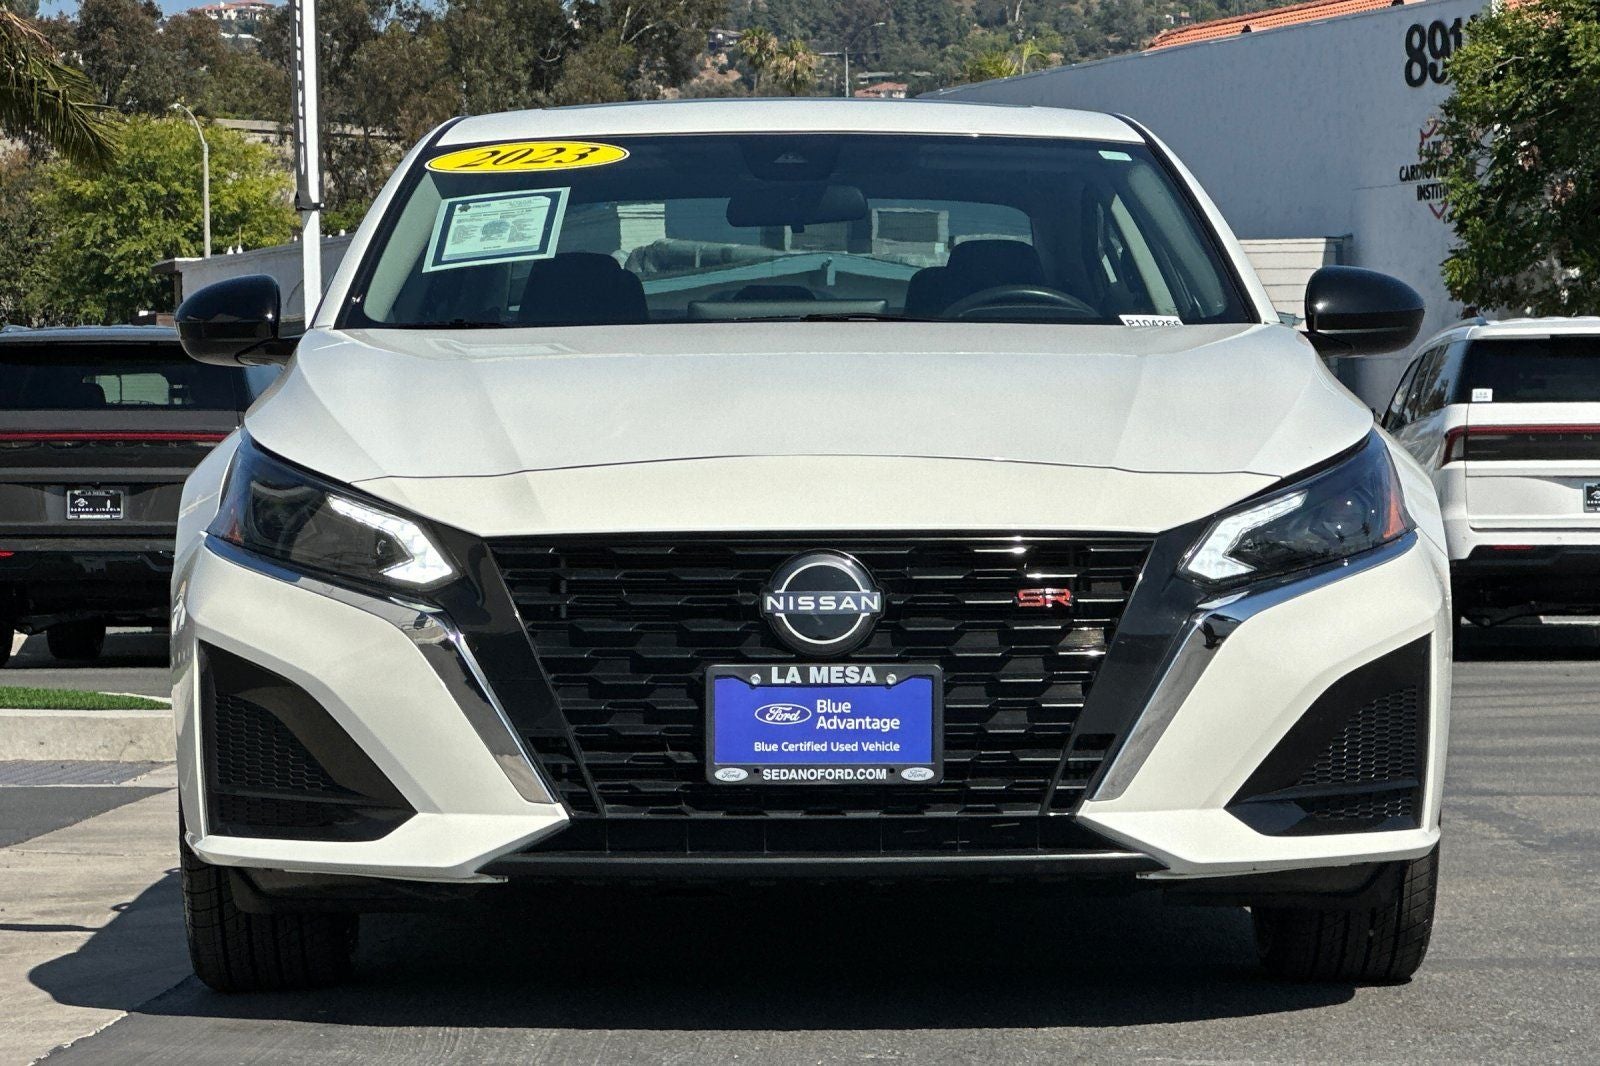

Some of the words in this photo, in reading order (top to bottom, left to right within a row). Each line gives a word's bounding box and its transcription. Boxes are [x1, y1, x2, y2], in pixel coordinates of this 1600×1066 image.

[1404, 14, 1478, 87] 891
[455, 147, 600, 169] 2023
[766, 595, 879, 611] NISSAN
[1017, 587, 1073, 608] SR
[771, 666, 802, 684] LA
[809, 666, 877, 684] MESA
[816, 699, 852, 714] Blue
[816, 715, 901, 733] Advantage
[754, 741, 779, 752] Blue
[781, 741, 828, 752] Certified
[830, 741, 859, 752] Used
[861, 741, 901, 752] Vehicle
[762, 768, 887, 781] SEDANOFORD.COM
